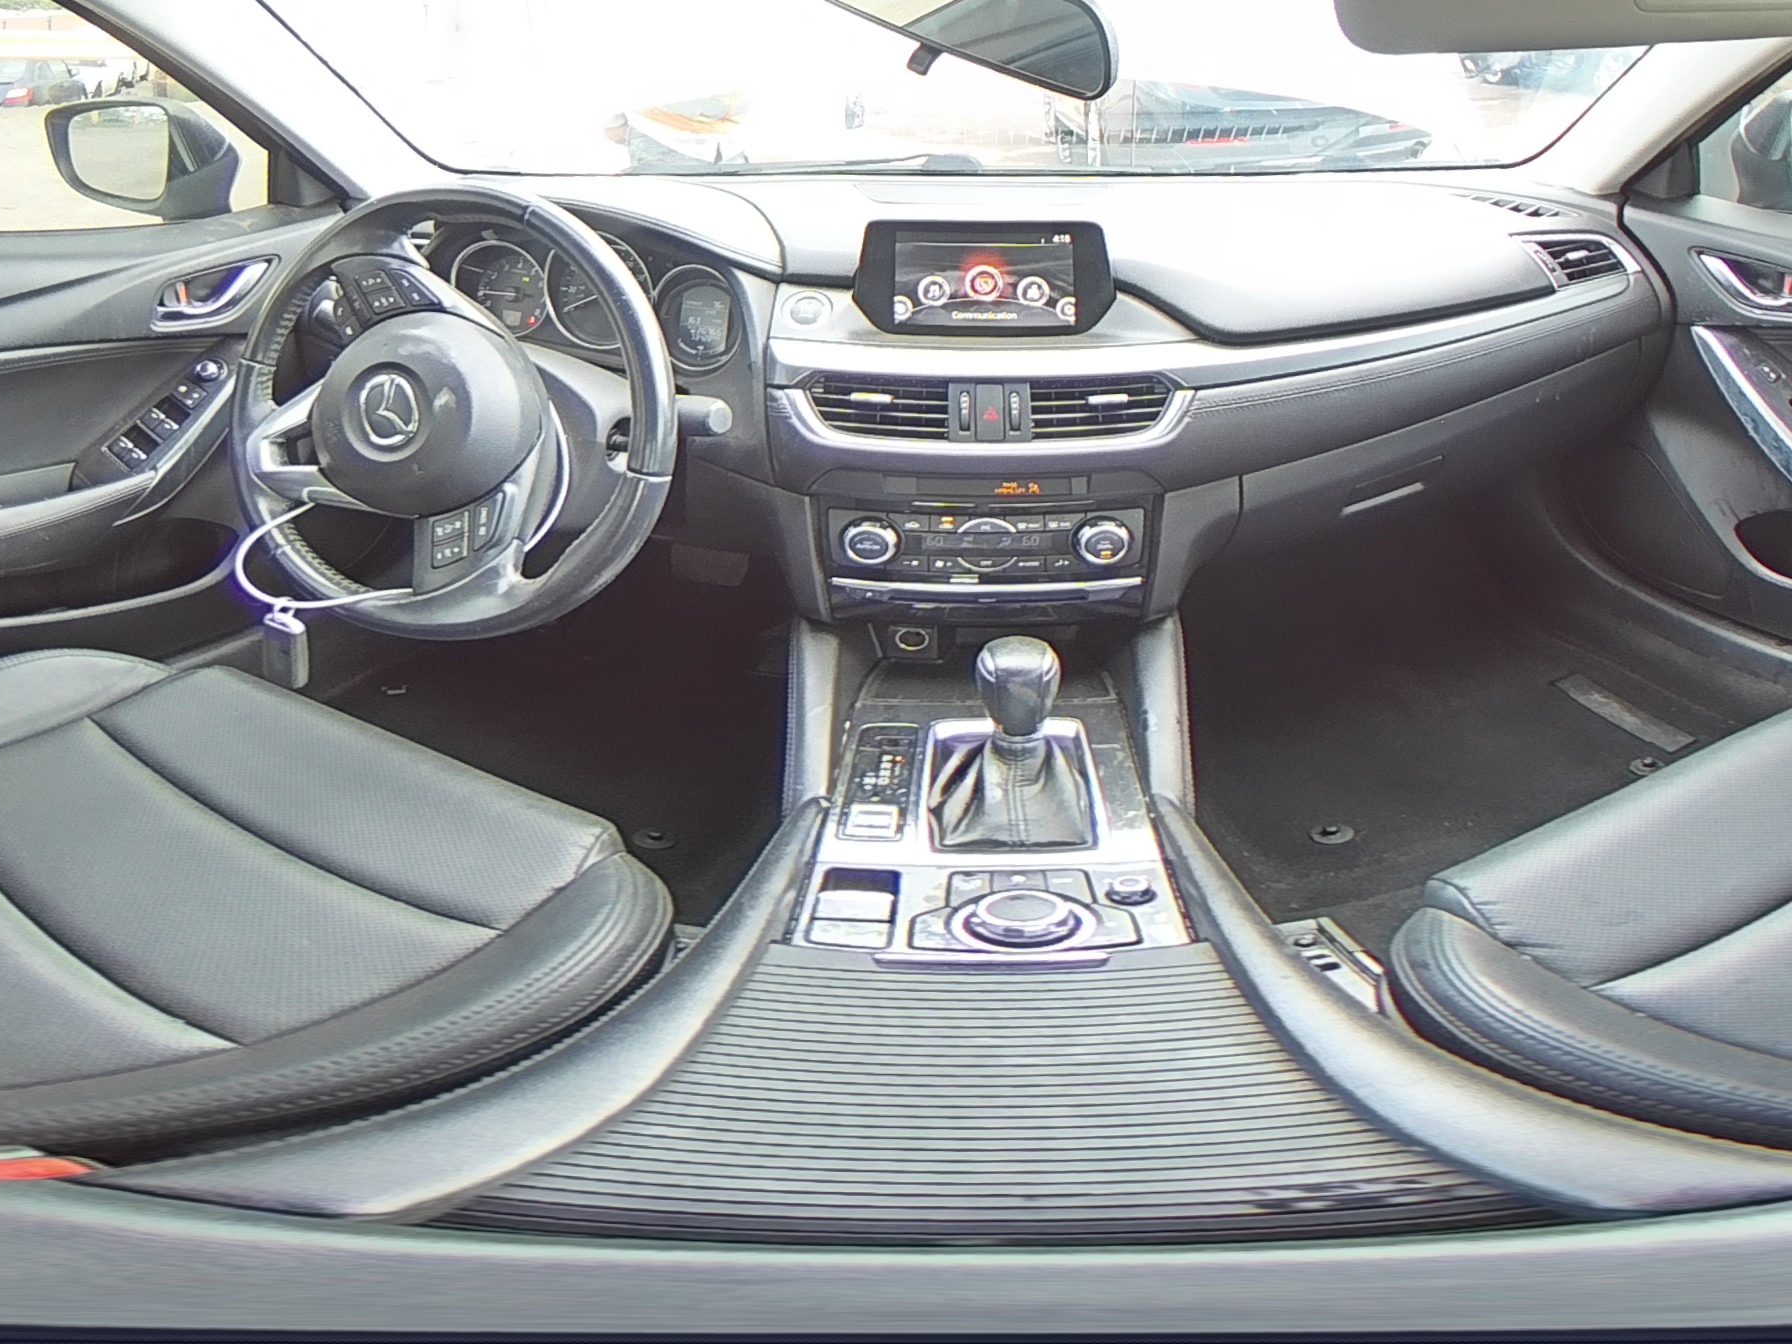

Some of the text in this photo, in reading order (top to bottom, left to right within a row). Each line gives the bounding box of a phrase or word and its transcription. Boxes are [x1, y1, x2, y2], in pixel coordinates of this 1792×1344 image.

[951, 311, 1018, 320] Communication
[926, 536, 944, 547] 60
[1022, 535, 1040, 546] 60
